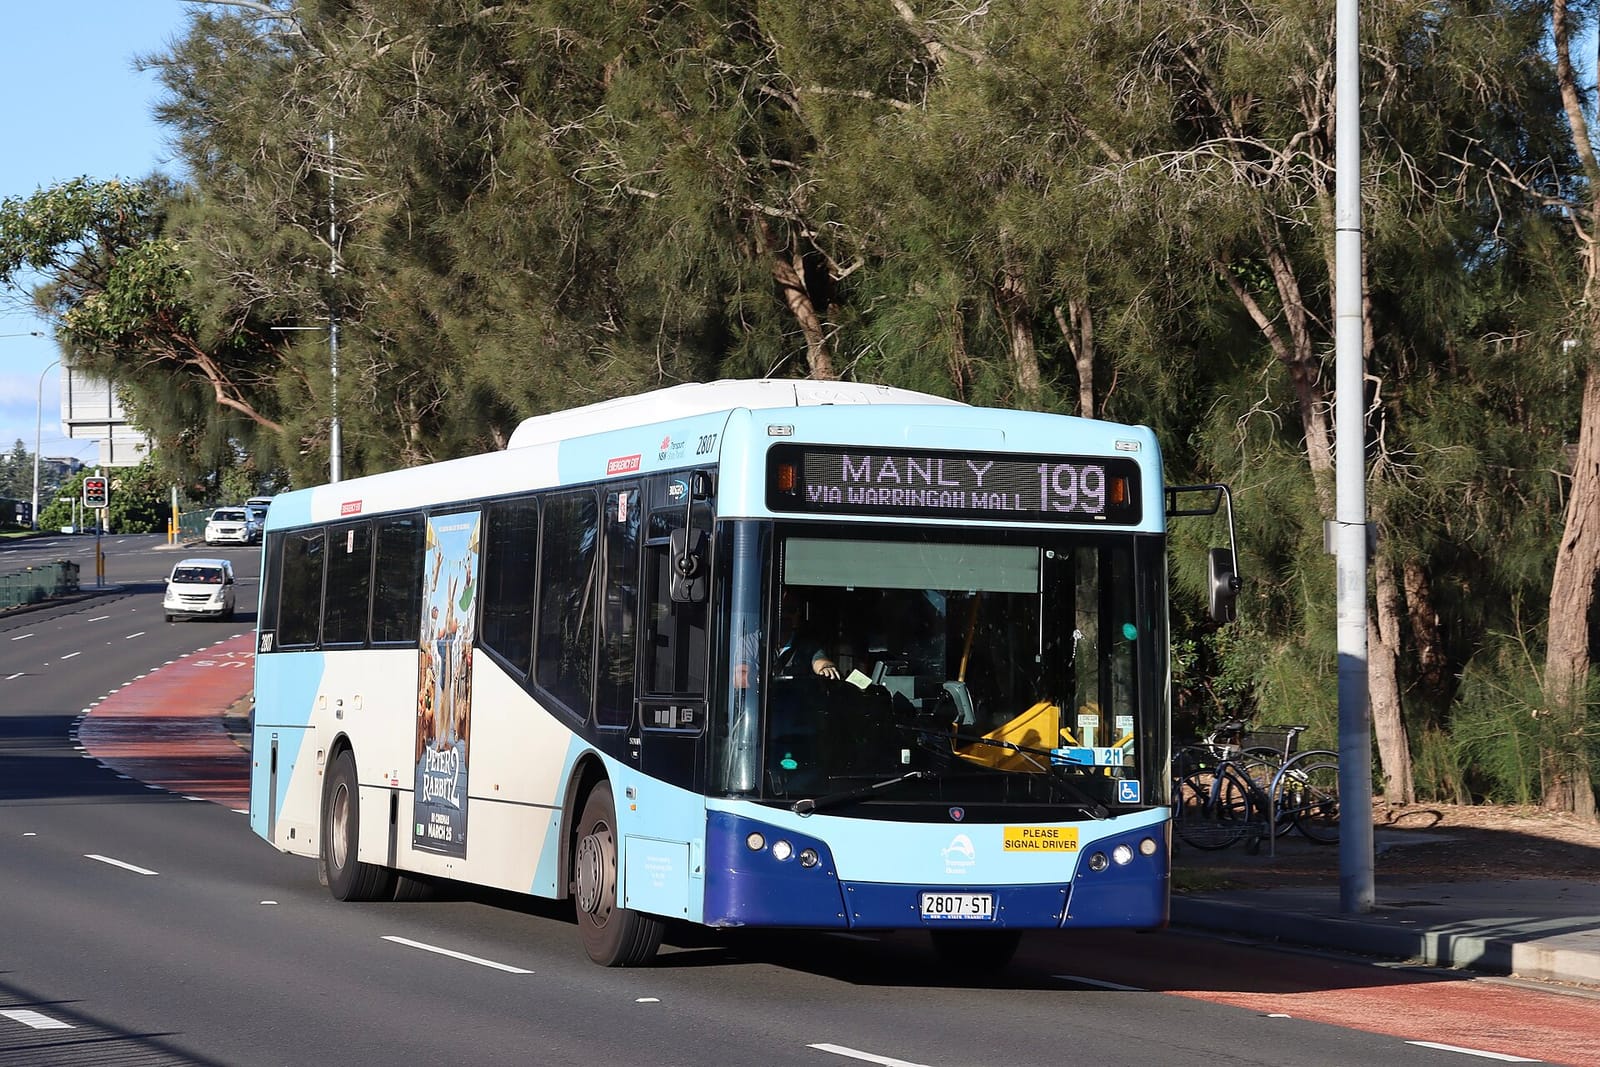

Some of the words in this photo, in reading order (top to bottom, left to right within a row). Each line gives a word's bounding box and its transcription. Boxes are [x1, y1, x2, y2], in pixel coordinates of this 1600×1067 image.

[696, 433, 717, 455] 2807
[842, 454, 994, 487] MANLY
[1038, 463, 1105, 513] 199
[808, 485, 842, 503] VIA
[848, 487, 965, 508] WARRINGAH
[972, 492, 1028, 511] MALL
[261, 633, 273, 652] 2807
[425, 745, 451, 775] PETER
[423, 773, 453, 802] RABBIT
[428, 823, 446, 840] MARCH
[1023, 829, 1059, 838] PLEASE
[1005, 840, 1040, 849] SIGNAL
[1043, 840, 1077, 849] DRIVER
